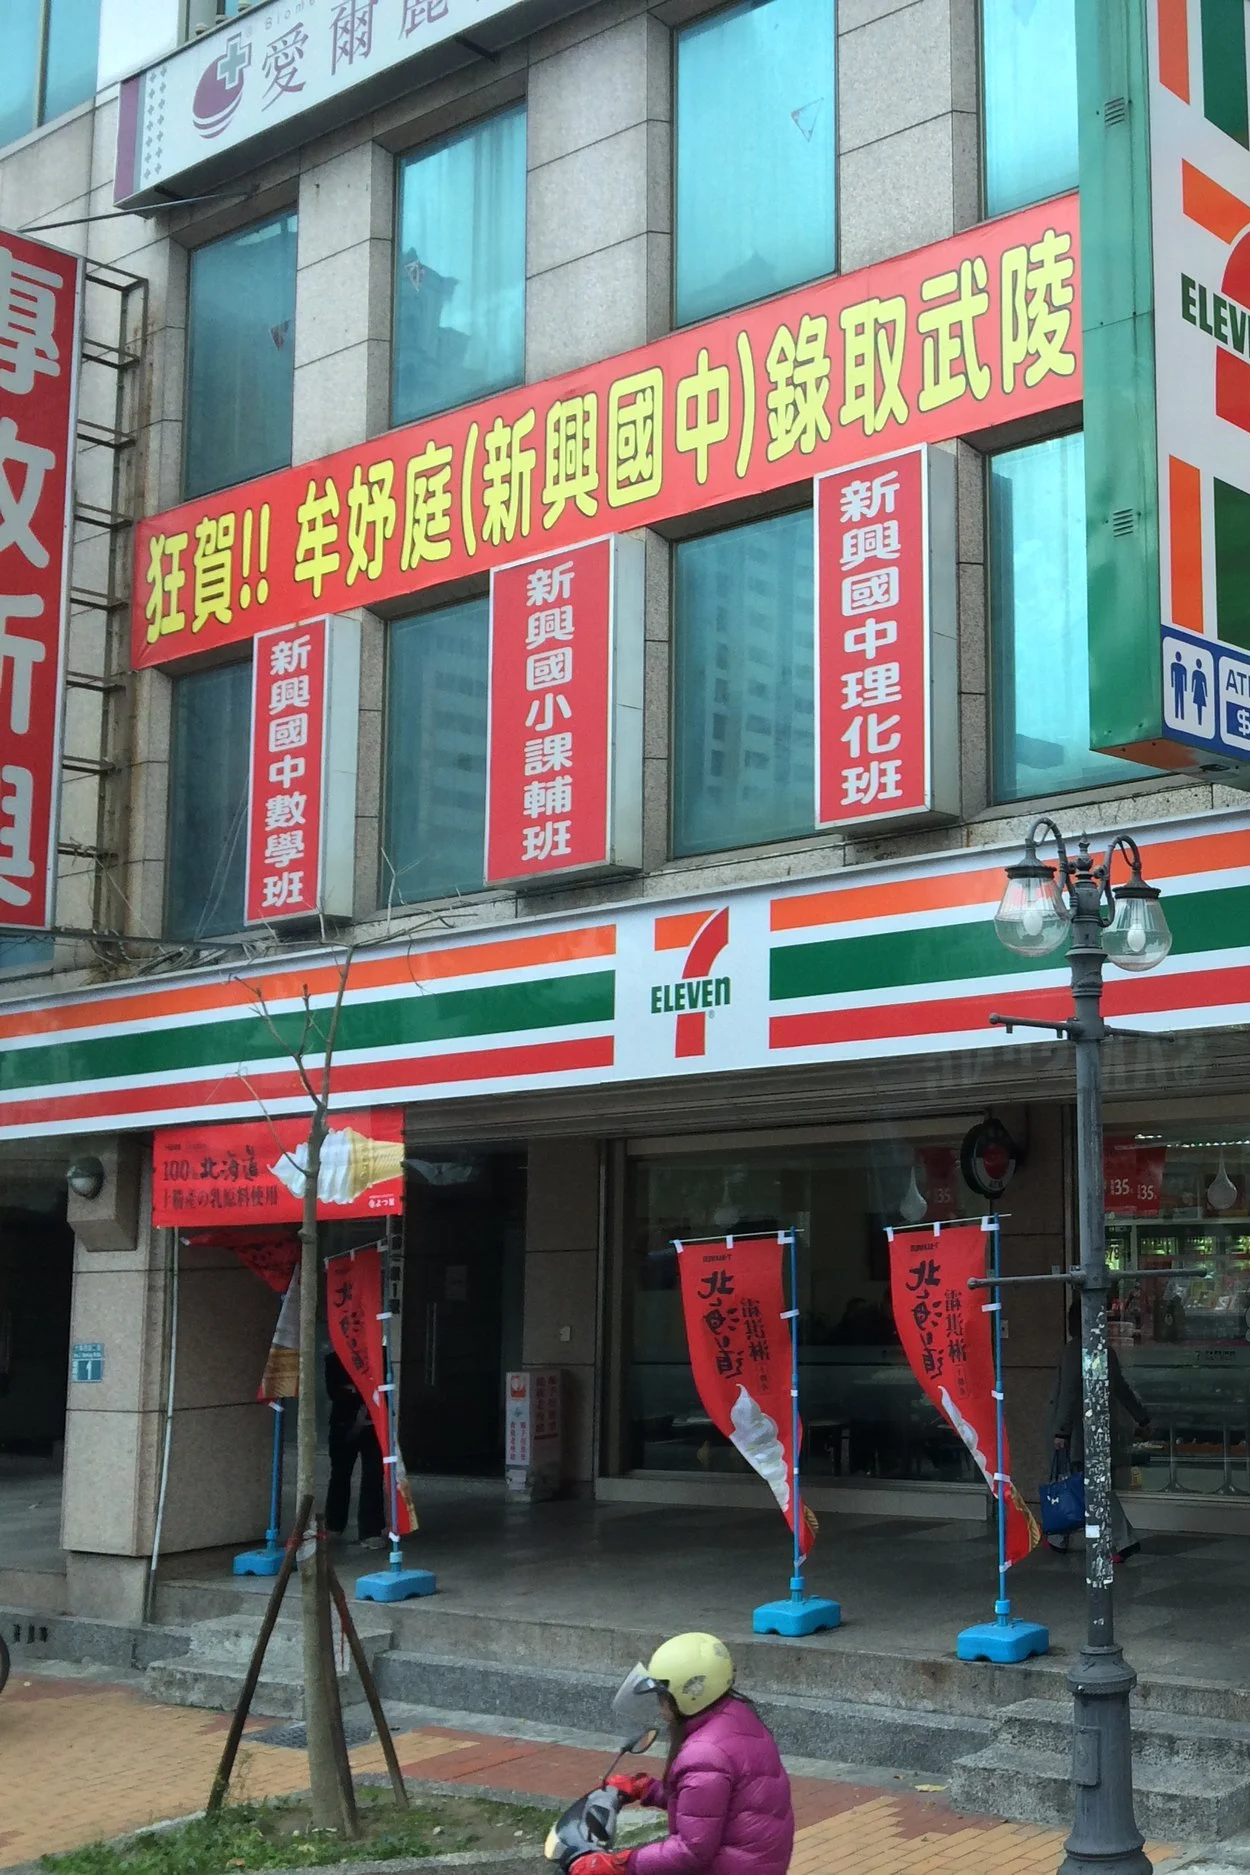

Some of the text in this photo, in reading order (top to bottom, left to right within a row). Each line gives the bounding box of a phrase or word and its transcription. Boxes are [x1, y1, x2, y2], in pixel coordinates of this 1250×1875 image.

[262, 633, 312, 908] 新興國中數學班
[520, 560, 575, 863] 新興國小課輔班
[840, 470, 903, 806] 新興國中理化班
[1114, 1178, 1129, 1195] 35
[1140, 1184, 1154, 1200] 35
